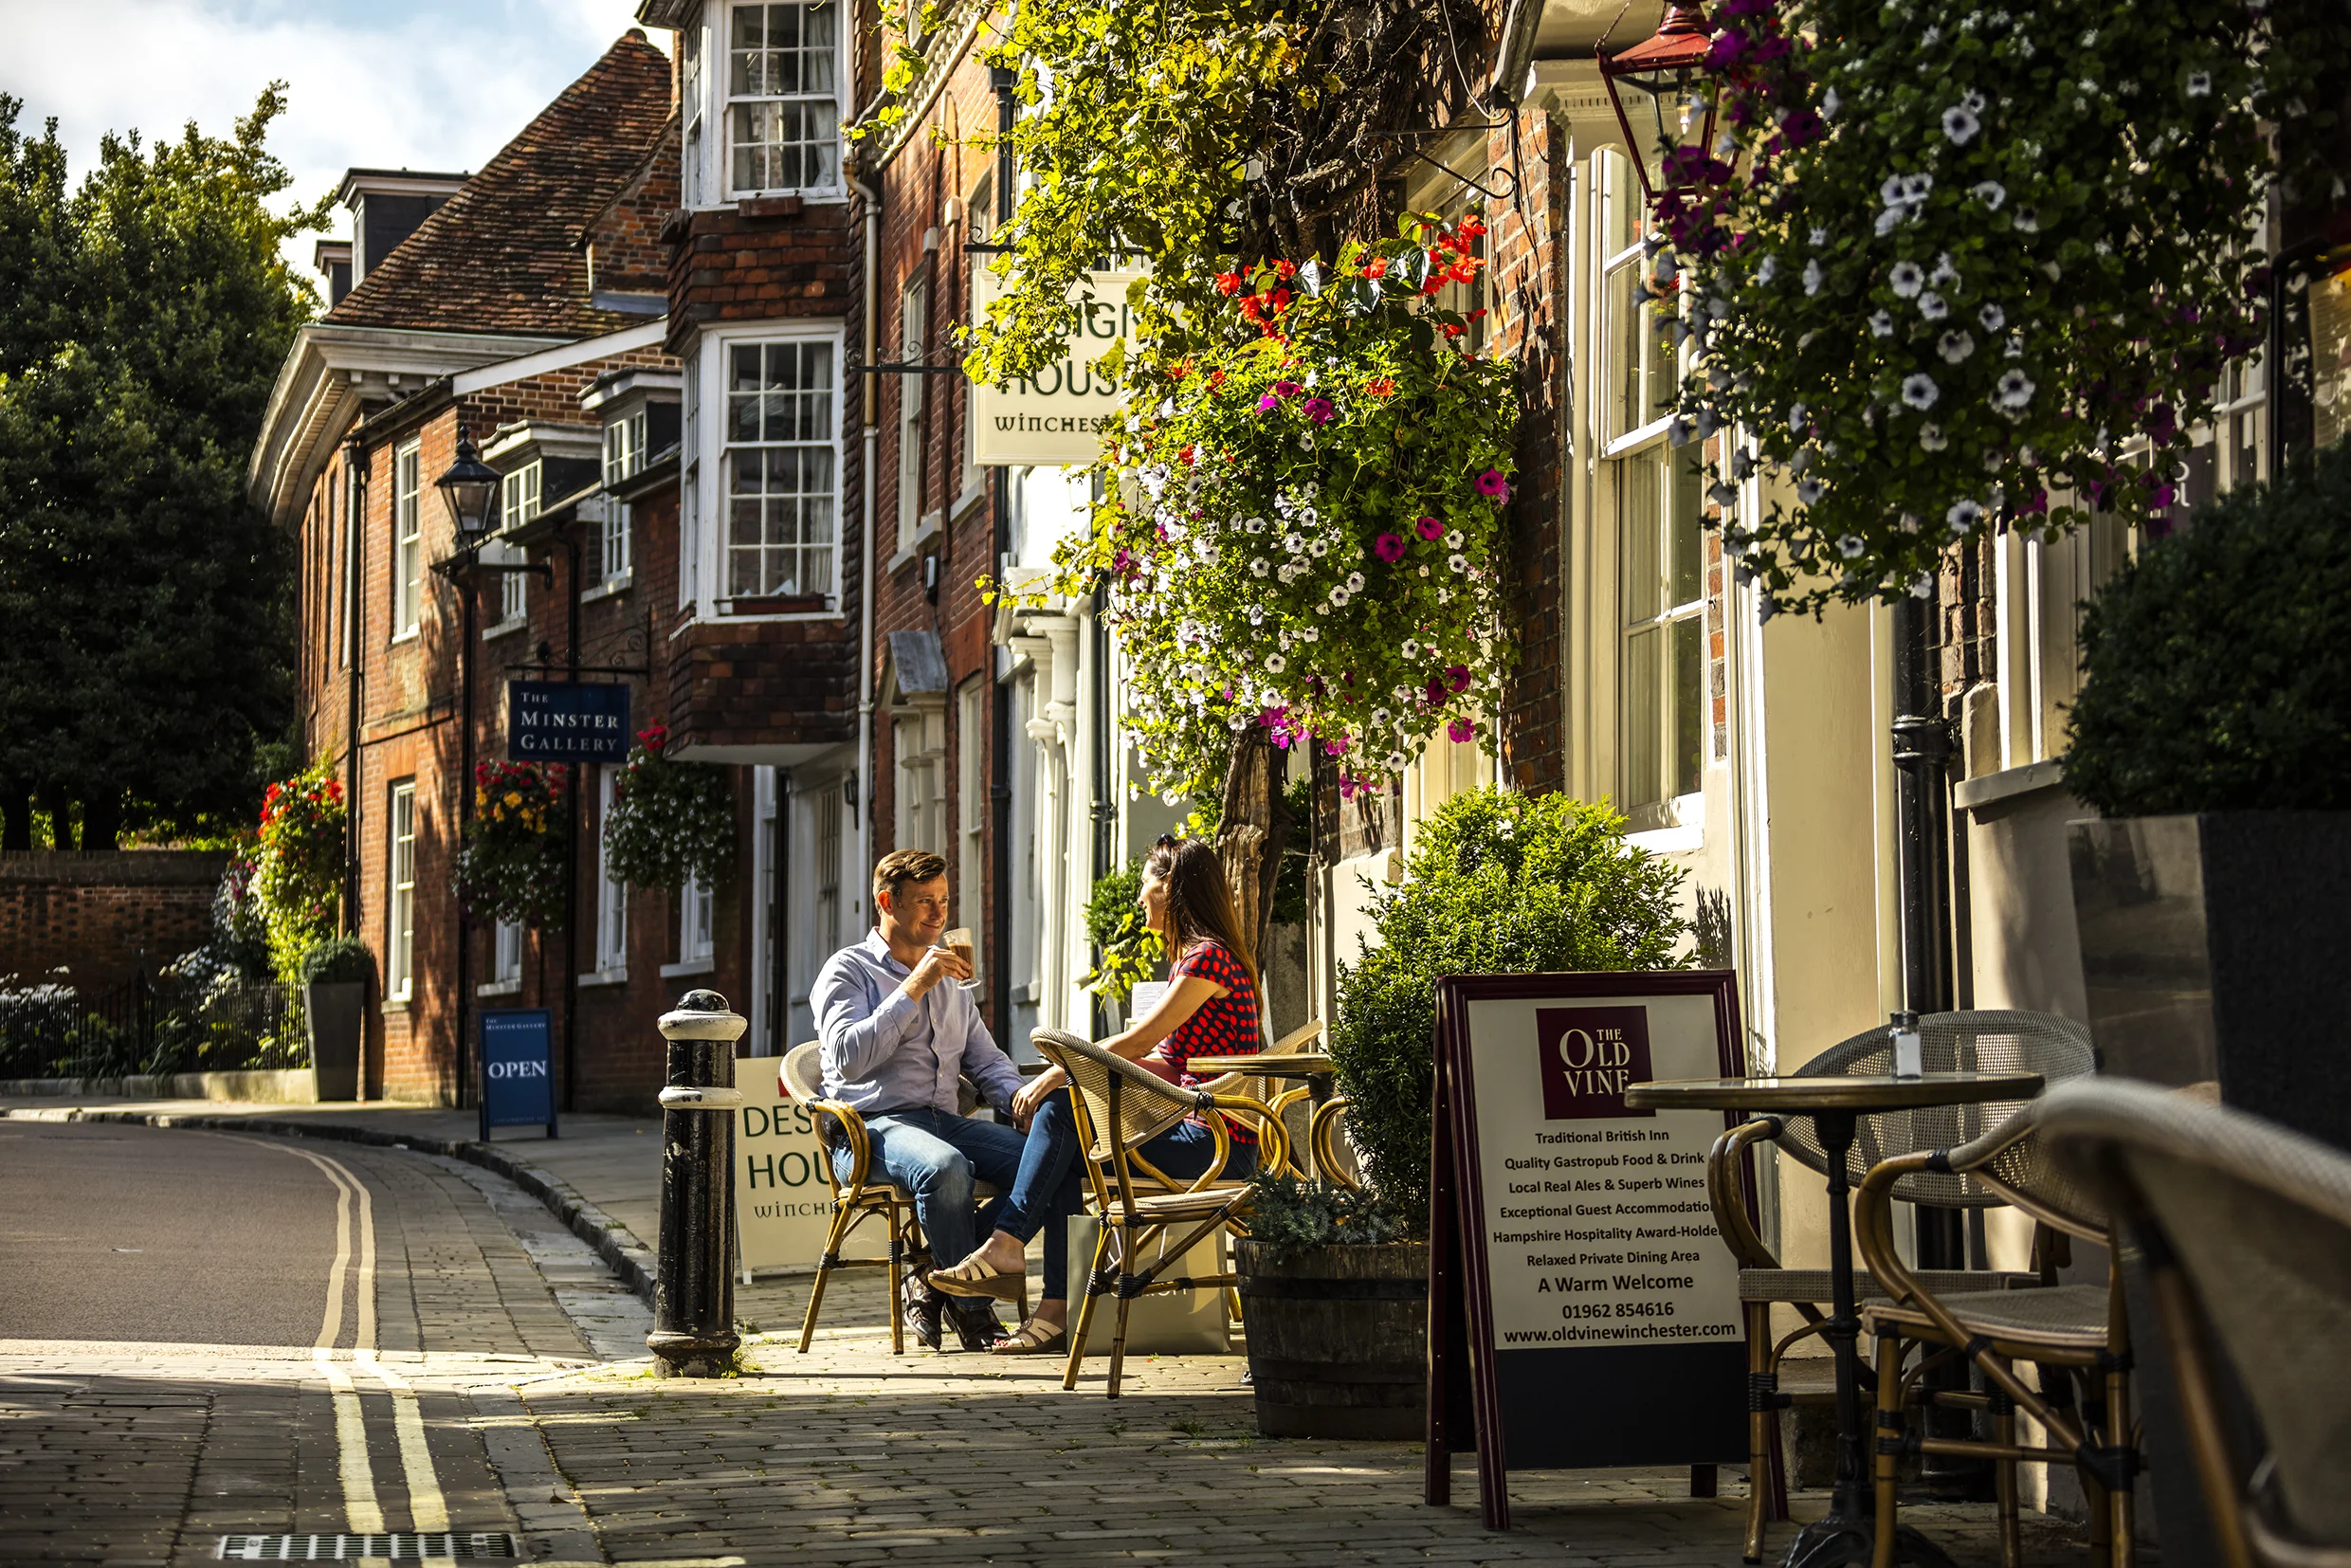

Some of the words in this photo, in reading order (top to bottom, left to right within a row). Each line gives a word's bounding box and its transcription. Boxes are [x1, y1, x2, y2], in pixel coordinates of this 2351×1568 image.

[520, 692, 549, 703] THE
[520, 711, 619, 728] MINSTER
[520, 734, 617, 752] GALLERY
[1596, 1029, 1622, 1041] THE
[1559, 1029, 1631, 1068] OLD
[487, 1060, 547, 1079] OPEN
[1562, 1069, 1630, 1097] VINE
[1535, 1130, 1603, 1144] Traditional
[1605, 1129, 1647, 1142] British
[1649, 1129, 1669, 1141] Inn
[1504, 1157, 1551, 1171] Quality
[1553, 1154, 1620, 1170] Gastropub
[1622, 1153, 1653, 1166] Food
[1656, 1153, 1668, 1165] &
[1670, 1151, 1705, 1165] Drink
[1508, 1180, 1541, 1194] Local
[1543, 1179, 1572, 1193] Real
[1574, 1179, 1601, 1192] Ales
[1604, 1178, 1615, 1191] &
[1617, 1176, 1663, 1193] Superb
[1665, 1176, 1705, 1189] Wines
[1500, 1204, 1573, 1220] Exceptional
[1575, 1204, 1613, 1216] Guest
[1614, 1200, 1712, 1215] Accommodatio
[1493, 1230, 1561, 1245] Hampshire
[1564, 1227, 1632, 1243] Hospitality
[1526, 1252, 1576, 1267] Relaxed
[1579, 1251, 1624, 1265] Private
[1627, 1250, 1668, 1266] Dining
[1670, 1250, 1701, 1263] Area
[1538, 1278, 1552, 1293] A
[1554, 1276, 1608, 1292] Warm
[1612, 1273, 1694, 1291] Welcome
[1561, 1304, 1612, 1320] 01962
[1615, 1302, 1675, 1318] 854616
[1504, 1323, 1737, 1342] www.oldvinewinchester.com
